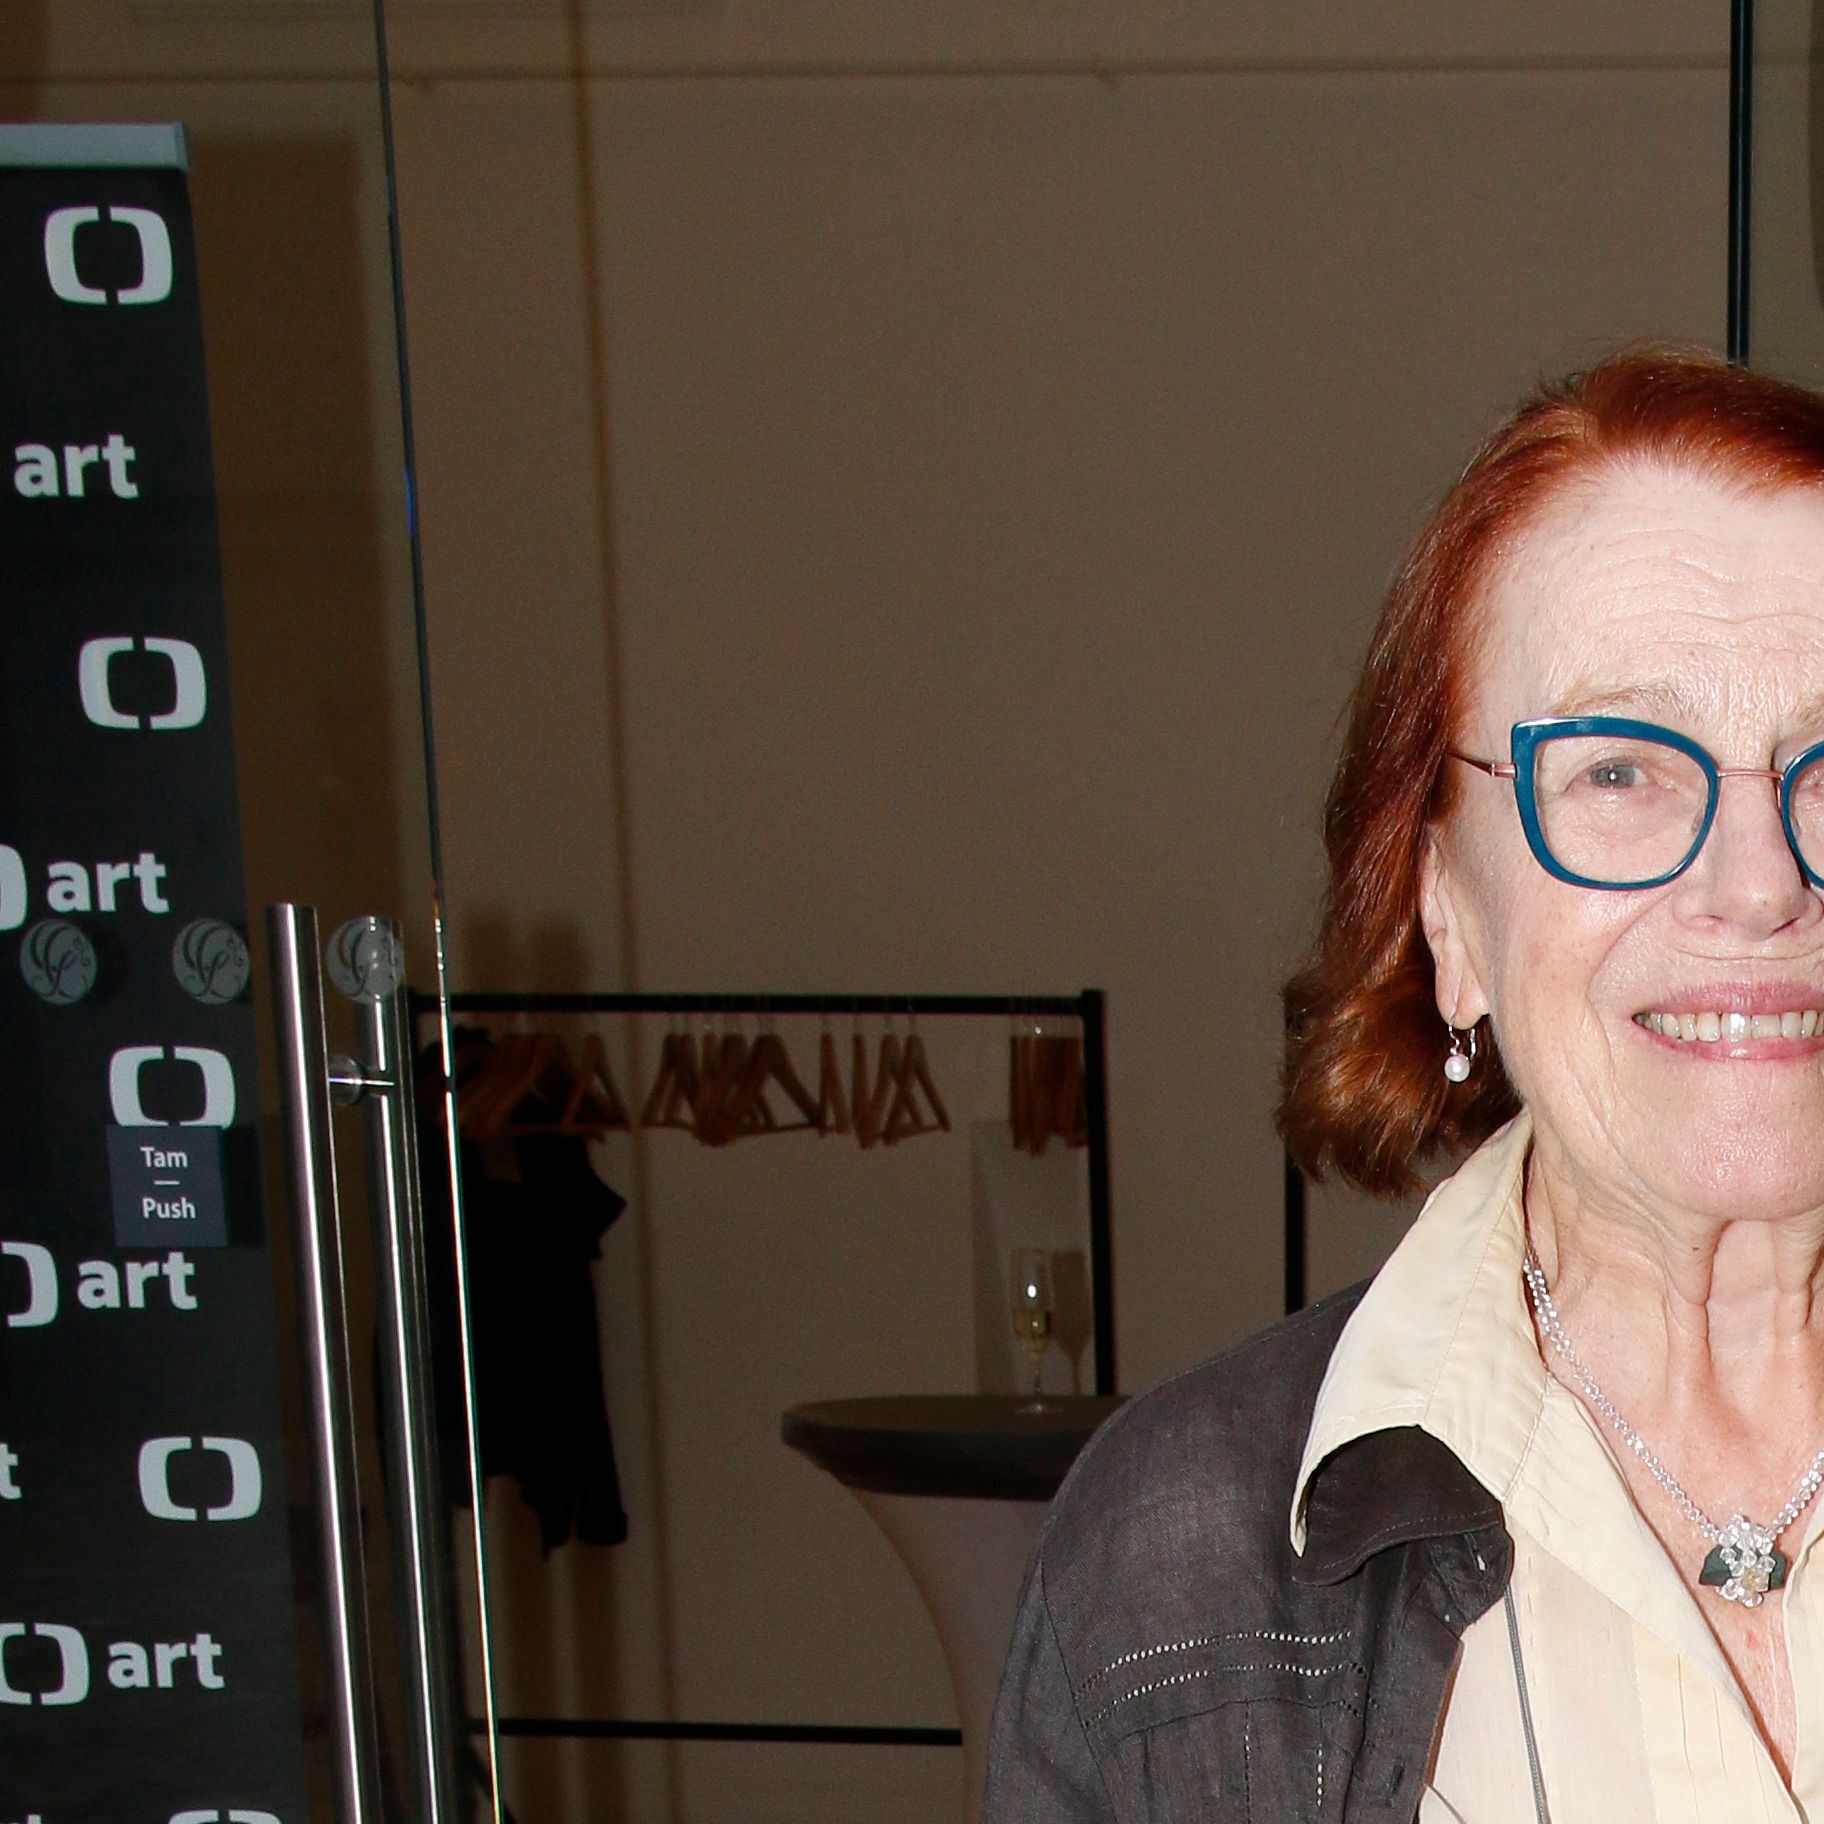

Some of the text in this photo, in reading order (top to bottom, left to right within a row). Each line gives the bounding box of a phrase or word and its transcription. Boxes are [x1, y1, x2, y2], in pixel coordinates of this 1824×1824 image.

[13, 433, 139, 499] art
[47, 852, 170, 914] art
[140, 1146, 189, 1168] Tam
[142, 1196, 196, 1219] Push
[77, 1251, 198, 1310] art
[107, 1633, 225, 1689] art
